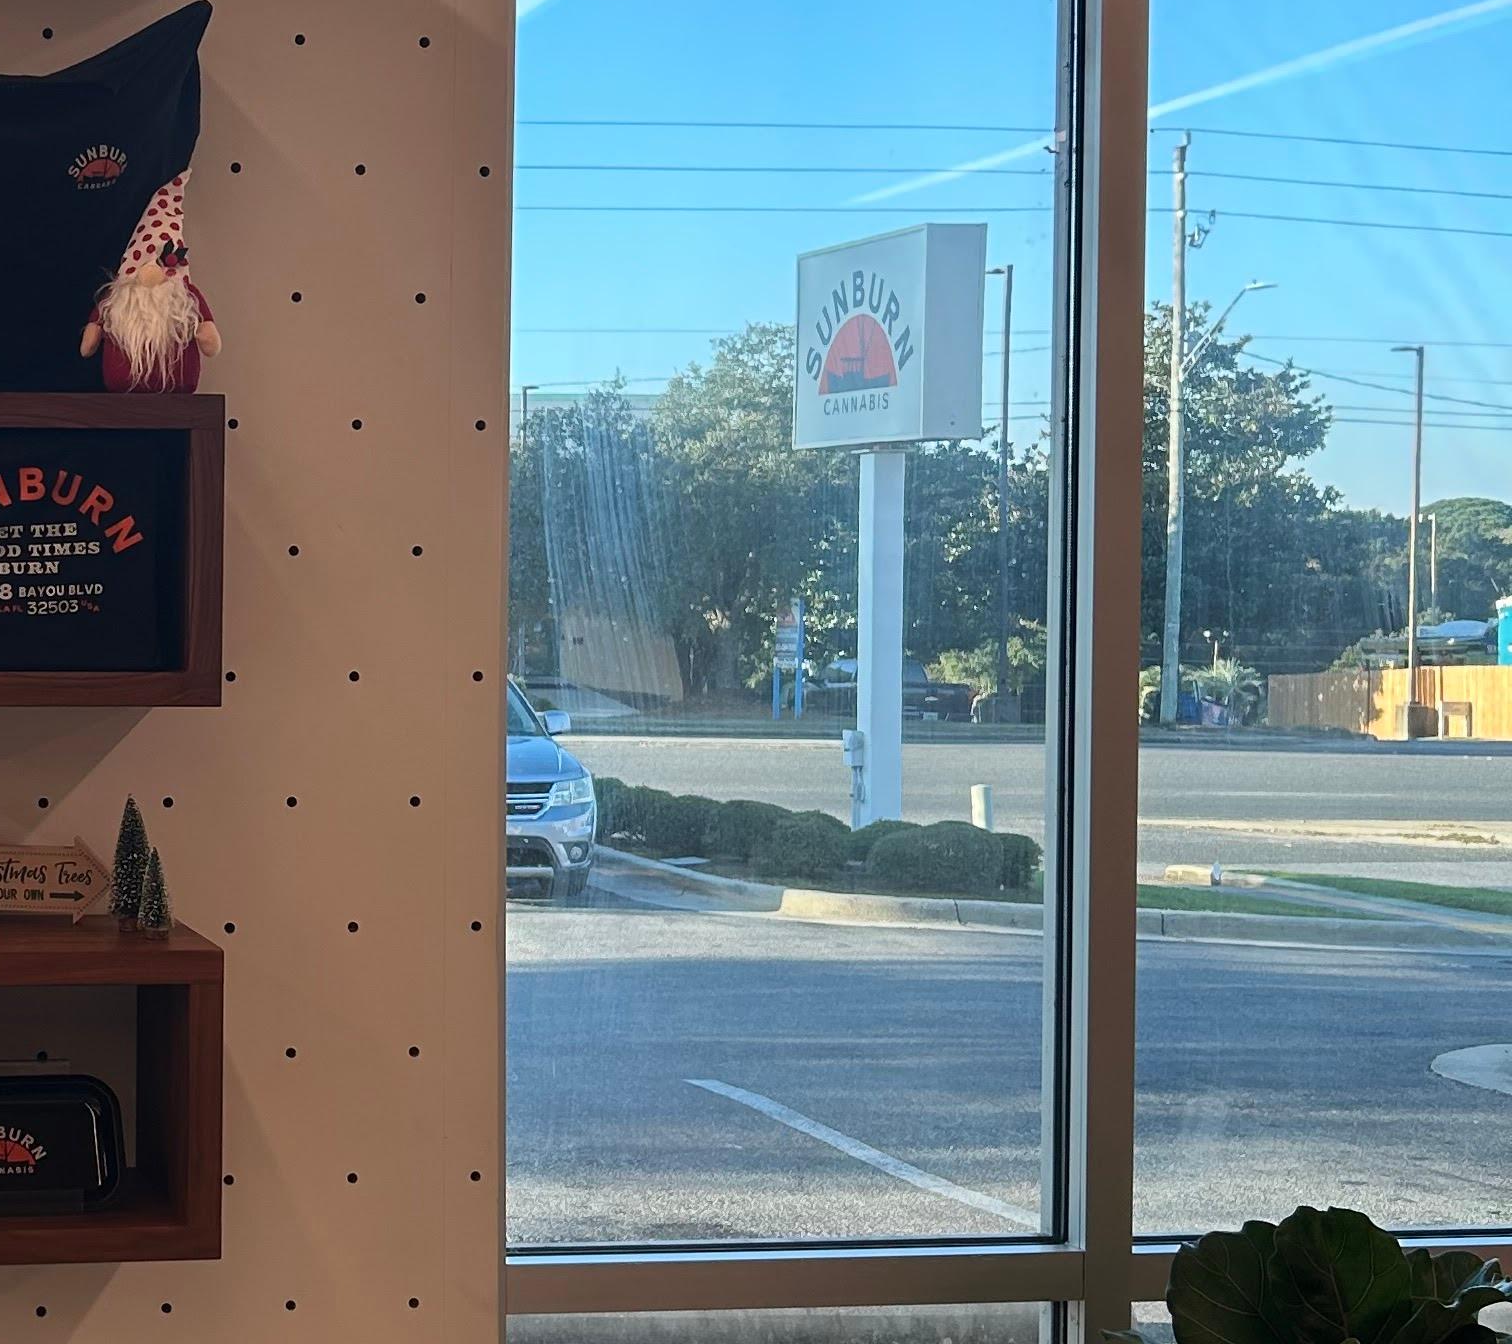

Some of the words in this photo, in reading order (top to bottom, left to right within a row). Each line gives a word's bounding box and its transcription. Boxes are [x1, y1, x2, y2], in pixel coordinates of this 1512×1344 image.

[805, 269, 914, 381] SUNBURN
[823, 392, 890, 416] CANNABIS
[30, 522, 78, 538] THE
[28, 541, 101, 557] TIMES
[18, 585, 65, 597] BAYOU
[68, 583, 104, 596] BLVD
[27, 599, 79, 615] 32503
[54, 862, 93, 886] Trees
[23, 888, 45, 901] OWN
